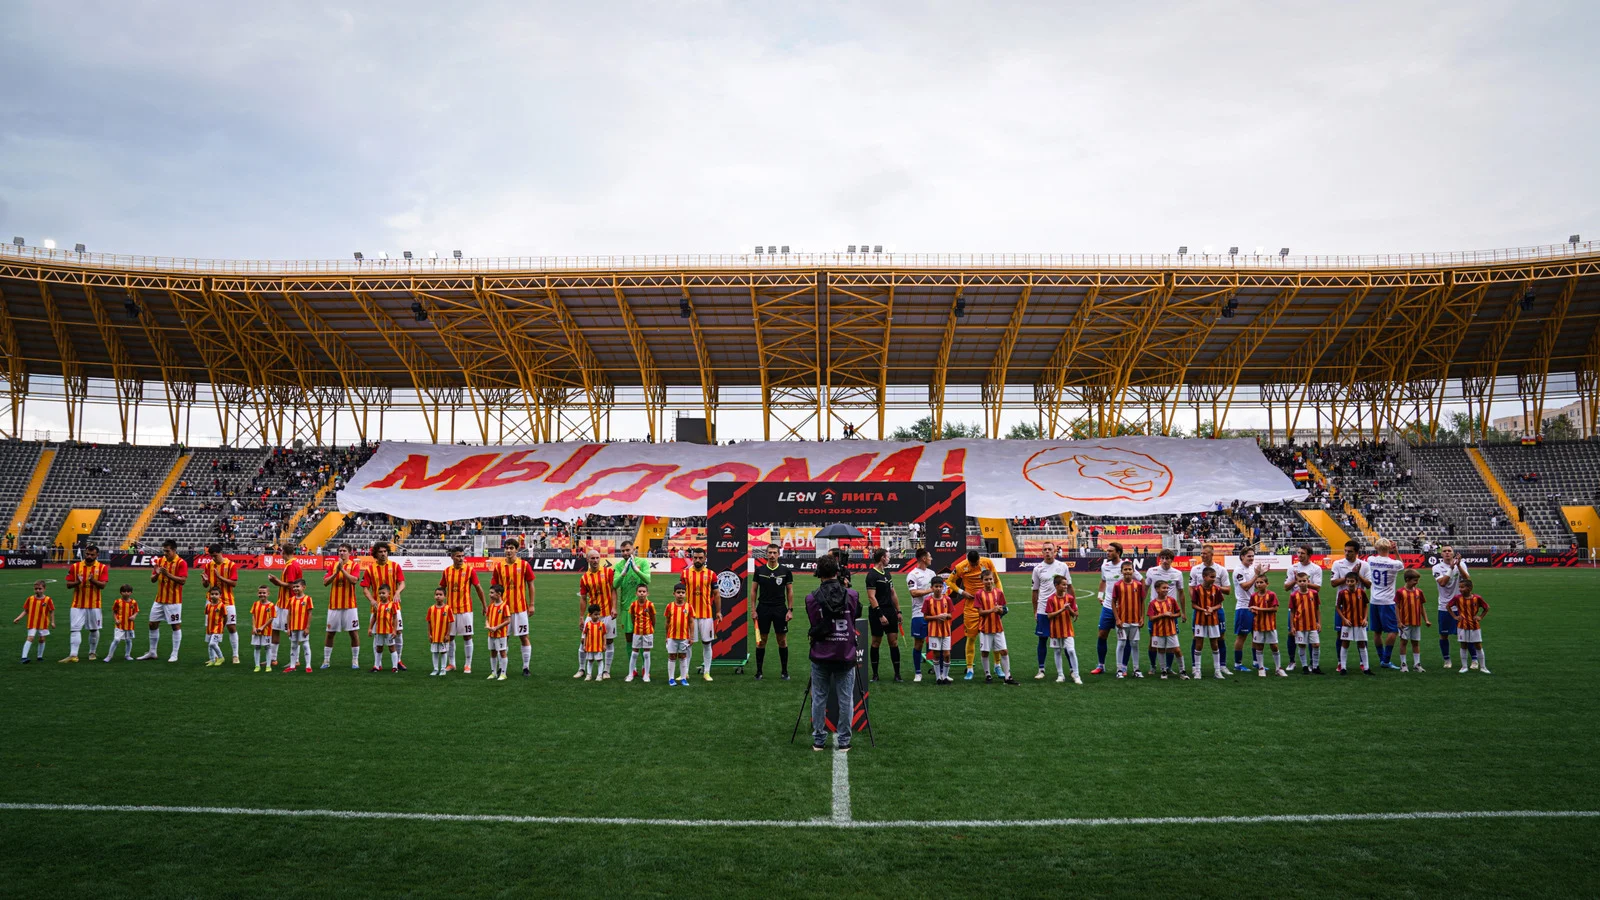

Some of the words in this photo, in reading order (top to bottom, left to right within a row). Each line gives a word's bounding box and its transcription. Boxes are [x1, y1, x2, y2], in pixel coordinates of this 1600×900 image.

[363, 444, 608, 490] МЫ
[778, 492, 817, 502] LEON
[841, 492, 884, 501] ЛИГА
[887, 492, 898, 501] А
[17, 558, 37, 566] Видео
[131, 556, 158, 565] LEO
[533, 559, 576, 570] LEON
[1373, 569, 1388, 587] 91
[518, 625, 527, 633] 75
